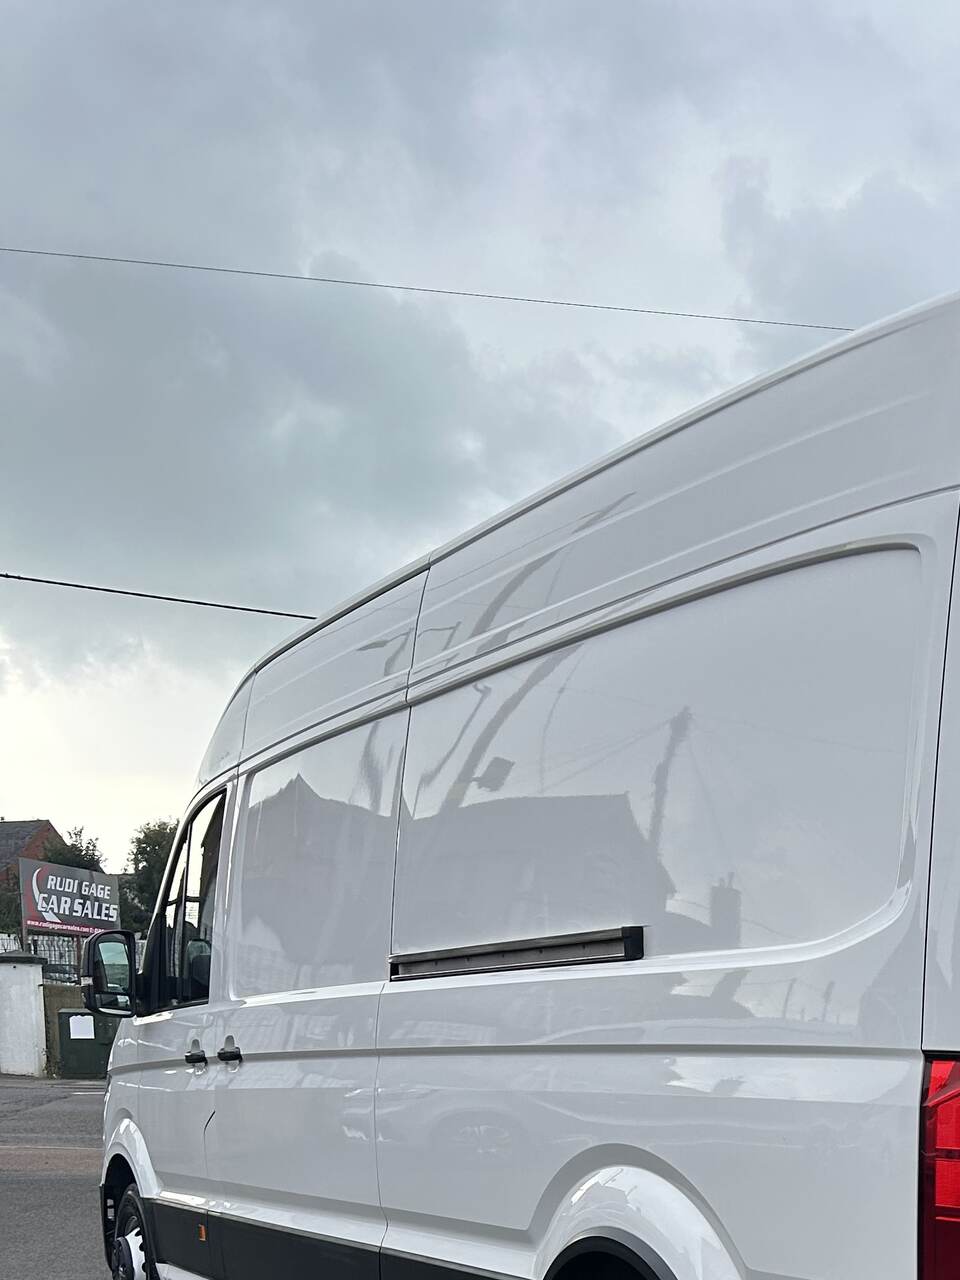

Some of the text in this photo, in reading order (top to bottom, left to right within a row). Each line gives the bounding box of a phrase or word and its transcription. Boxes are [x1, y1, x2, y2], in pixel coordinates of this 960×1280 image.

[47, 875, 112, 899] RUDI GAGE
[37, 893, 118, 922] CAR SALES
